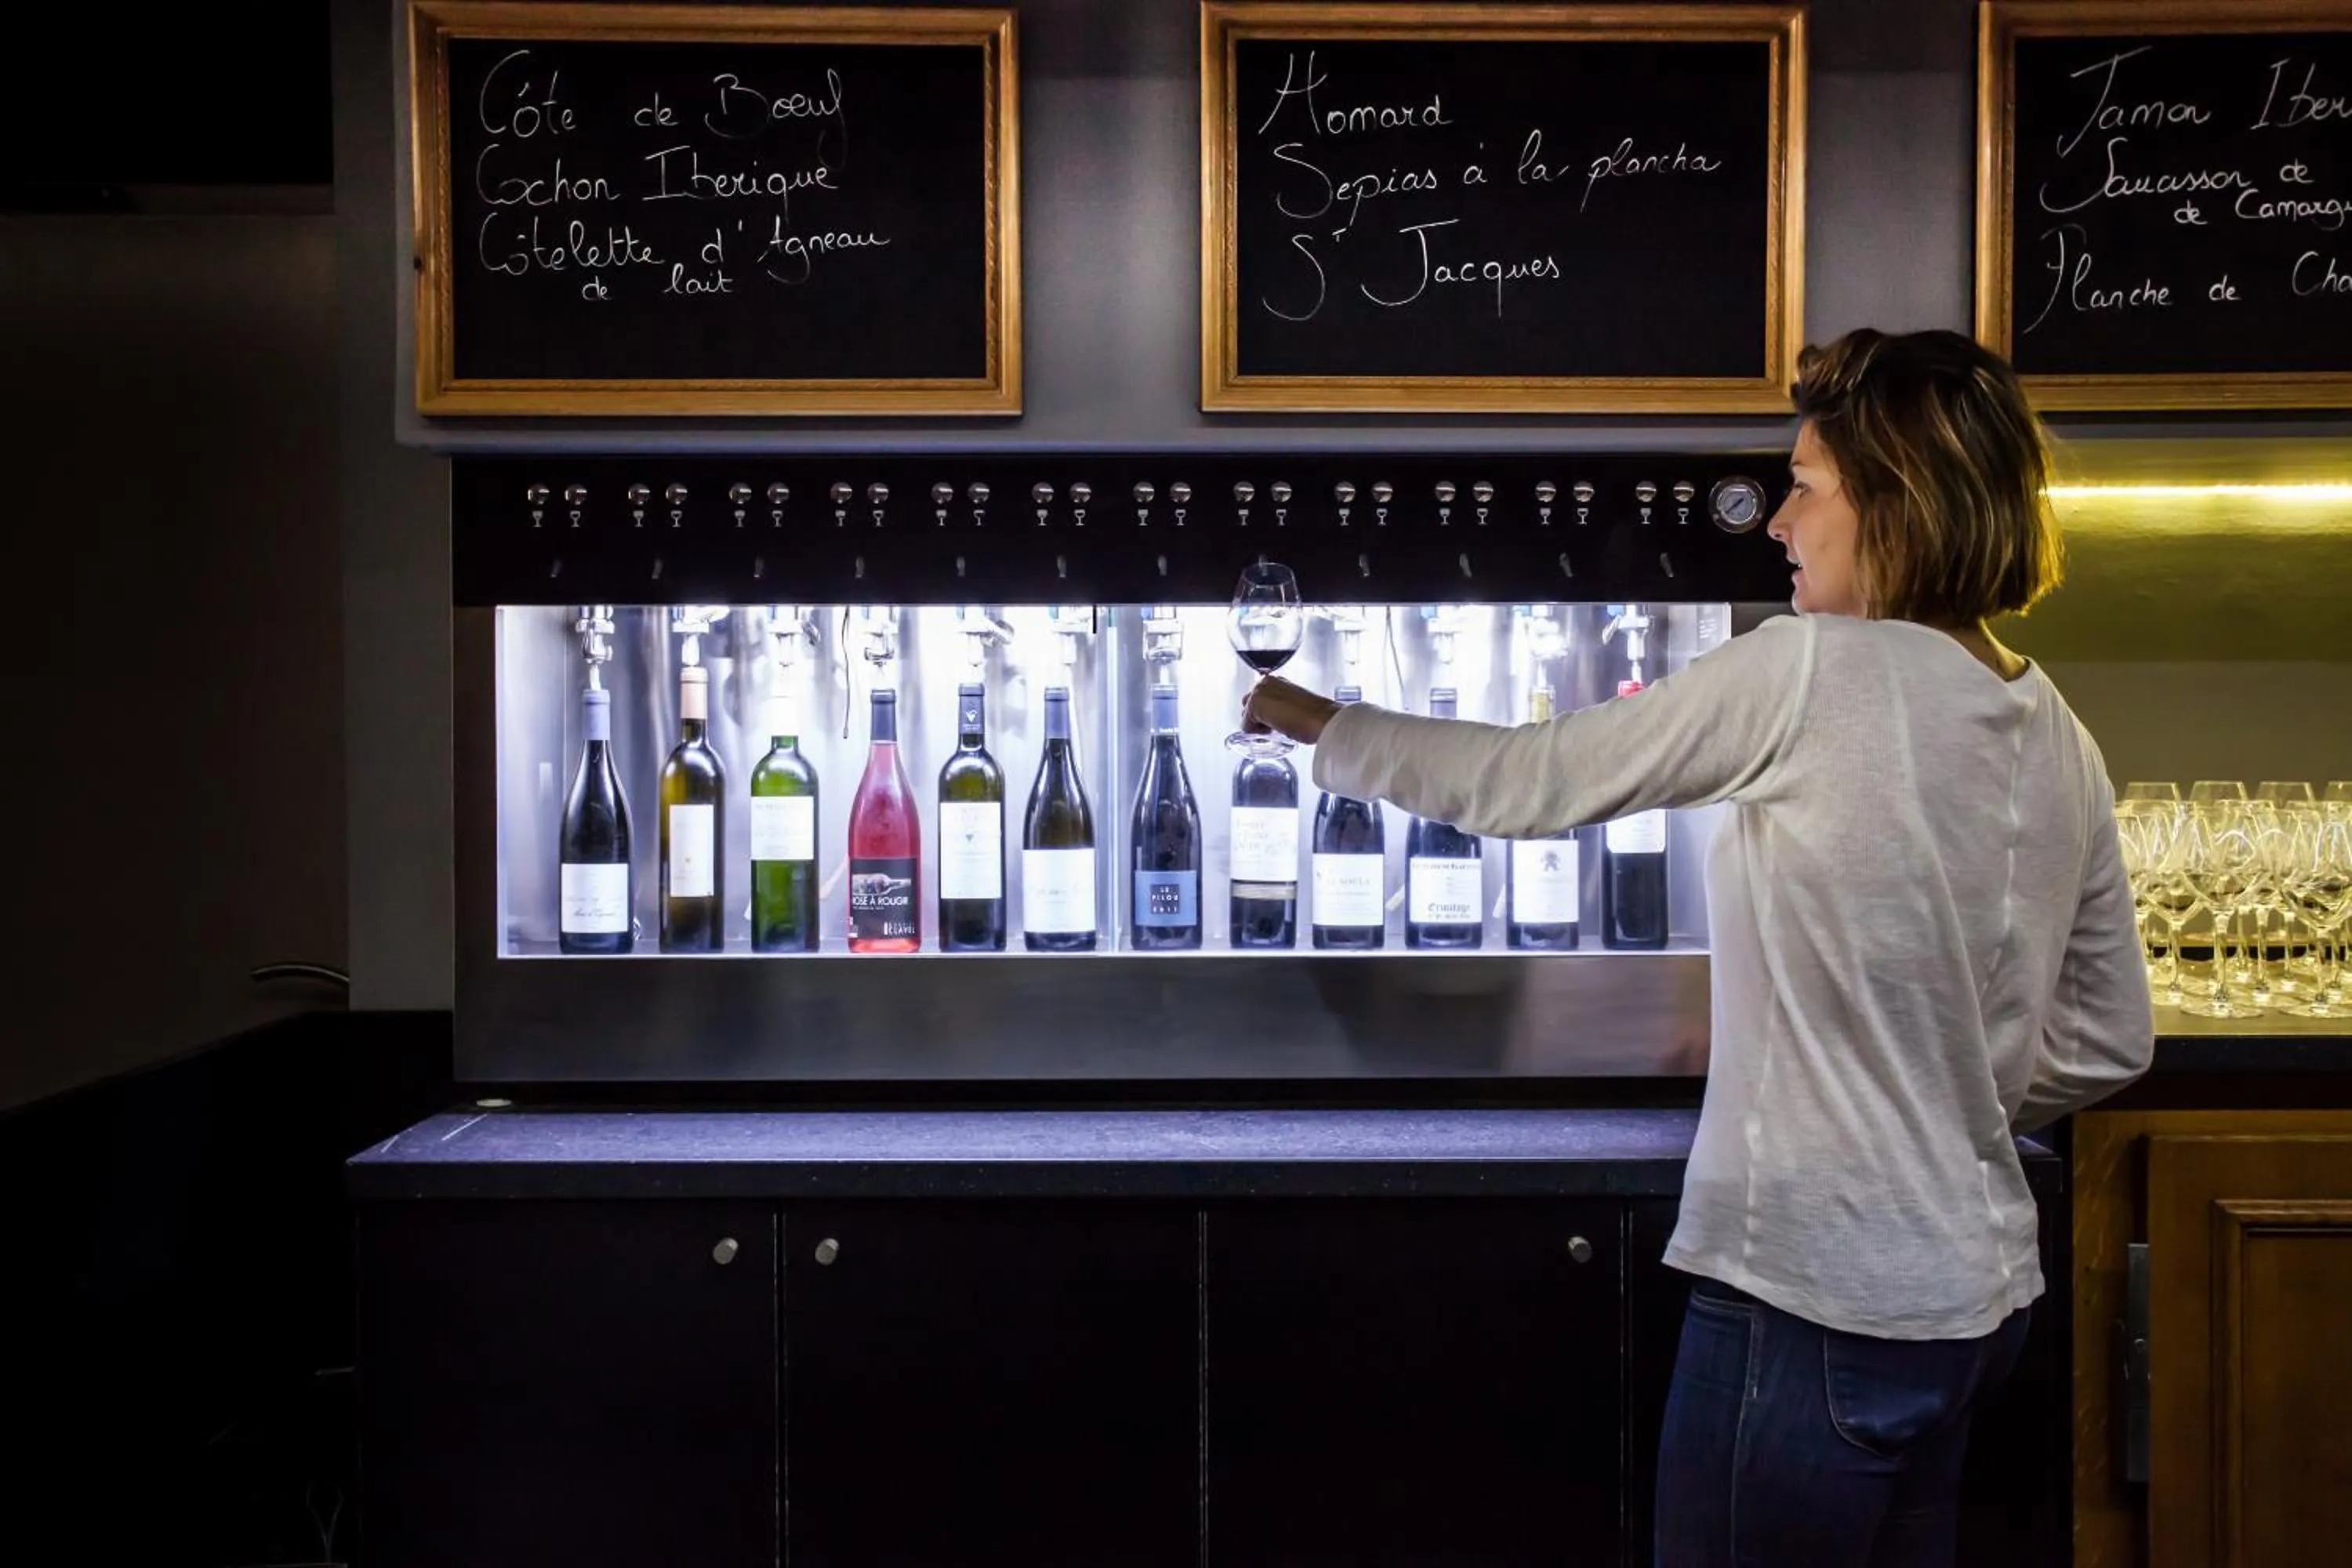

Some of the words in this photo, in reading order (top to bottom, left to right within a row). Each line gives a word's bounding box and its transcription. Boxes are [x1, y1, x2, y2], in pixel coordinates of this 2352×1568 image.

[633, 92, 679, 126] de
[1258, 50, 1455, 135] Homard
[2056, 45, 2213, 158] Jamon
[476, 143, 622, 206] Cochon
[1273, 143, 1439, 227] Sepias
[1517, 129, 1570, 185] la
[1579, 137, 1722, 212] plancha
[2279, 157, 2315, 183] de
[2173, 199, 2208, 225] de
[582, 276, 612, 301] de
[663, 263, 735, 295] lait
[1360, 218, 1564, 318] Jacques
[2023, 223, 2172, 334] Planche
[2208, 274, 2242, 302] de
